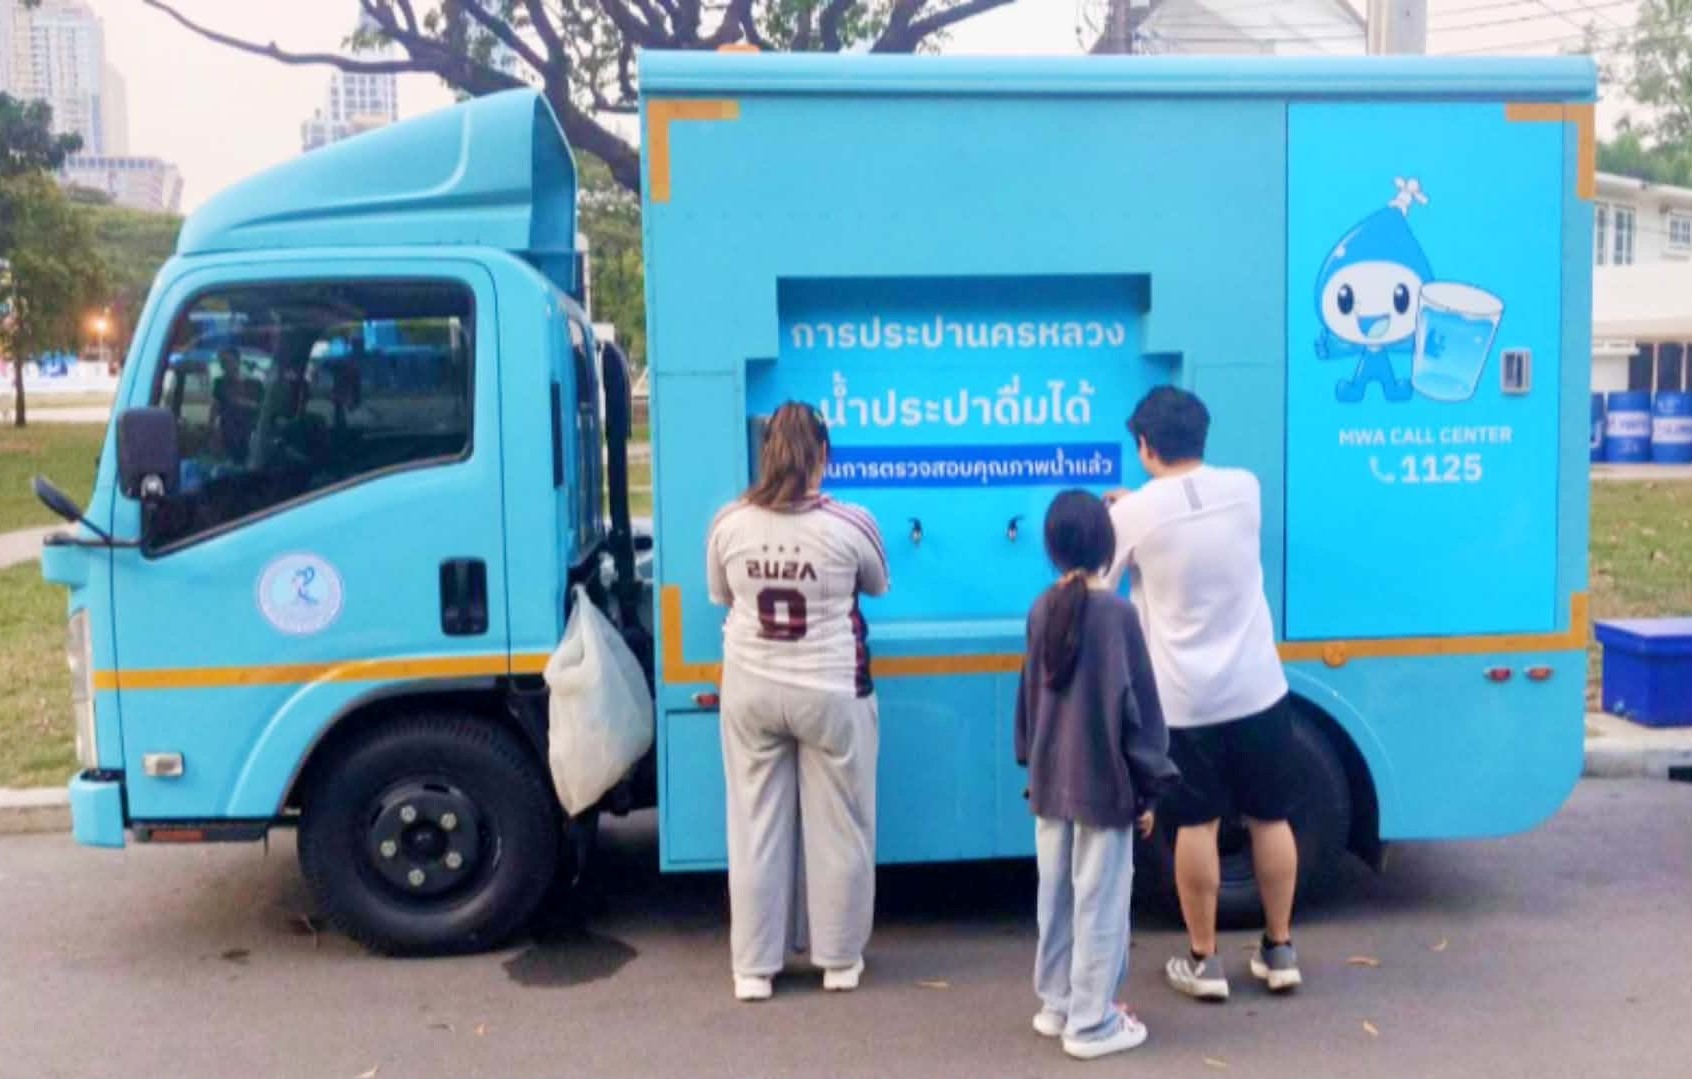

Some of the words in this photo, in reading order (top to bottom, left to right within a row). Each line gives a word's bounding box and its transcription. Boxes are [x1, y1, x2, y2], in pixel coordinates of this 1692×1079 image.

[792, 315, 1125, 348] การประปานครหลวง
[820, 370, 1096, 426] น้ำประปาดื่มได้
[1339, 428, 1386, 445] MWA
[1390, 427, 1434, 445] CALL
[1440, 425, 1512, 444] CENTER
[824, 447, 1113, 484] นการตรวจสอบคุณภาพน้ำแล้ว
[1401, 453, 1483, 483] 1125
